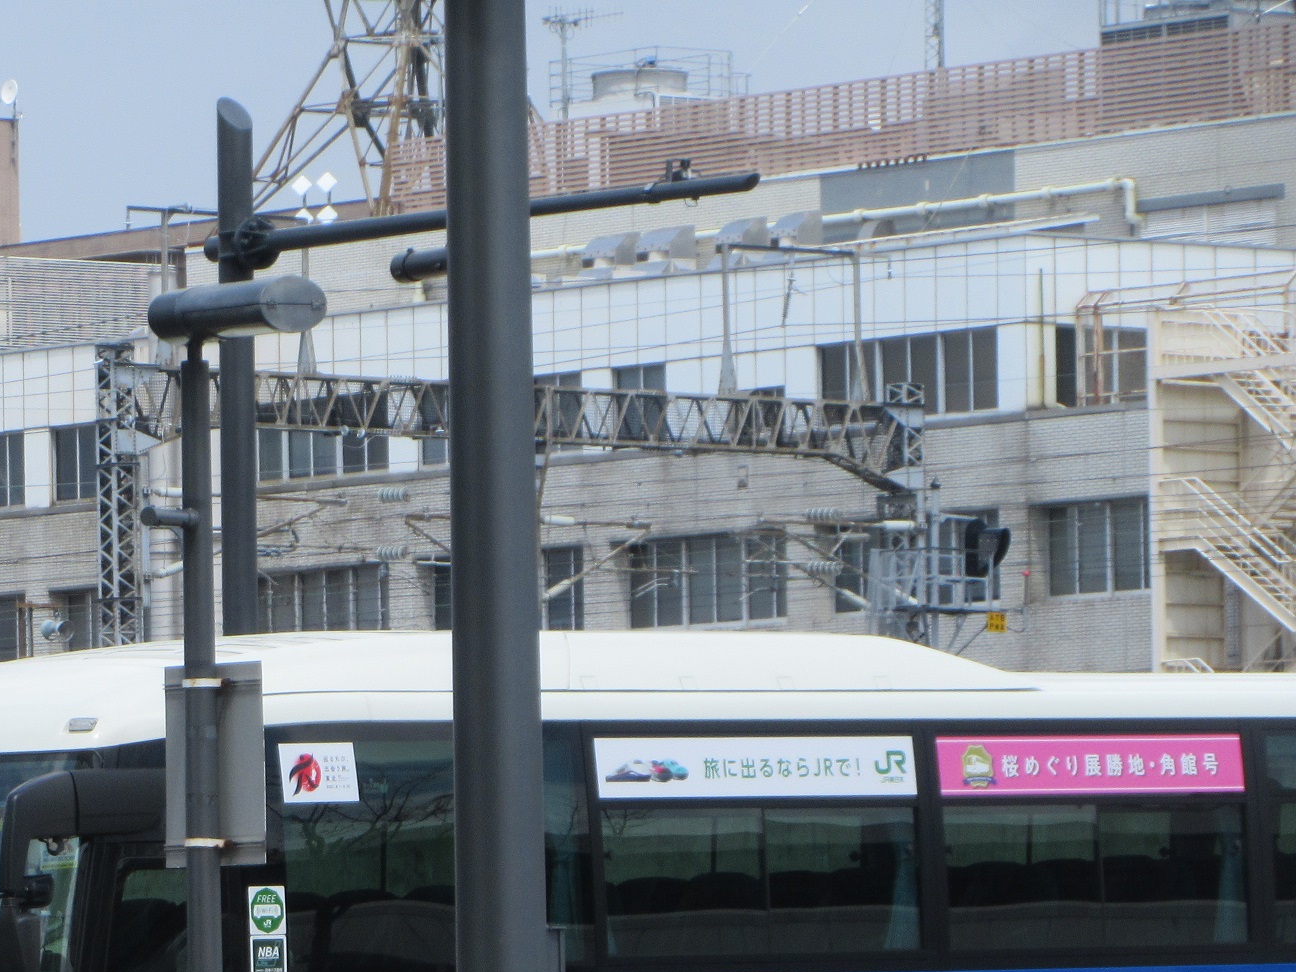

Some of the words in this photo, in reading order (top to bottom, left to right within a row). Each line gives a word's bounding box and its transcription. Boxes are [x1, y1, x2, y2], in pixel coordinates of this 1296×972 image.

[874, 750, 907, 774] JR
[1002, 753, 1219, 777] 桜めぐり展勝地・角館号
[257, 894, 277, 903] FREE
[258, 946, 279, 958] NBA
